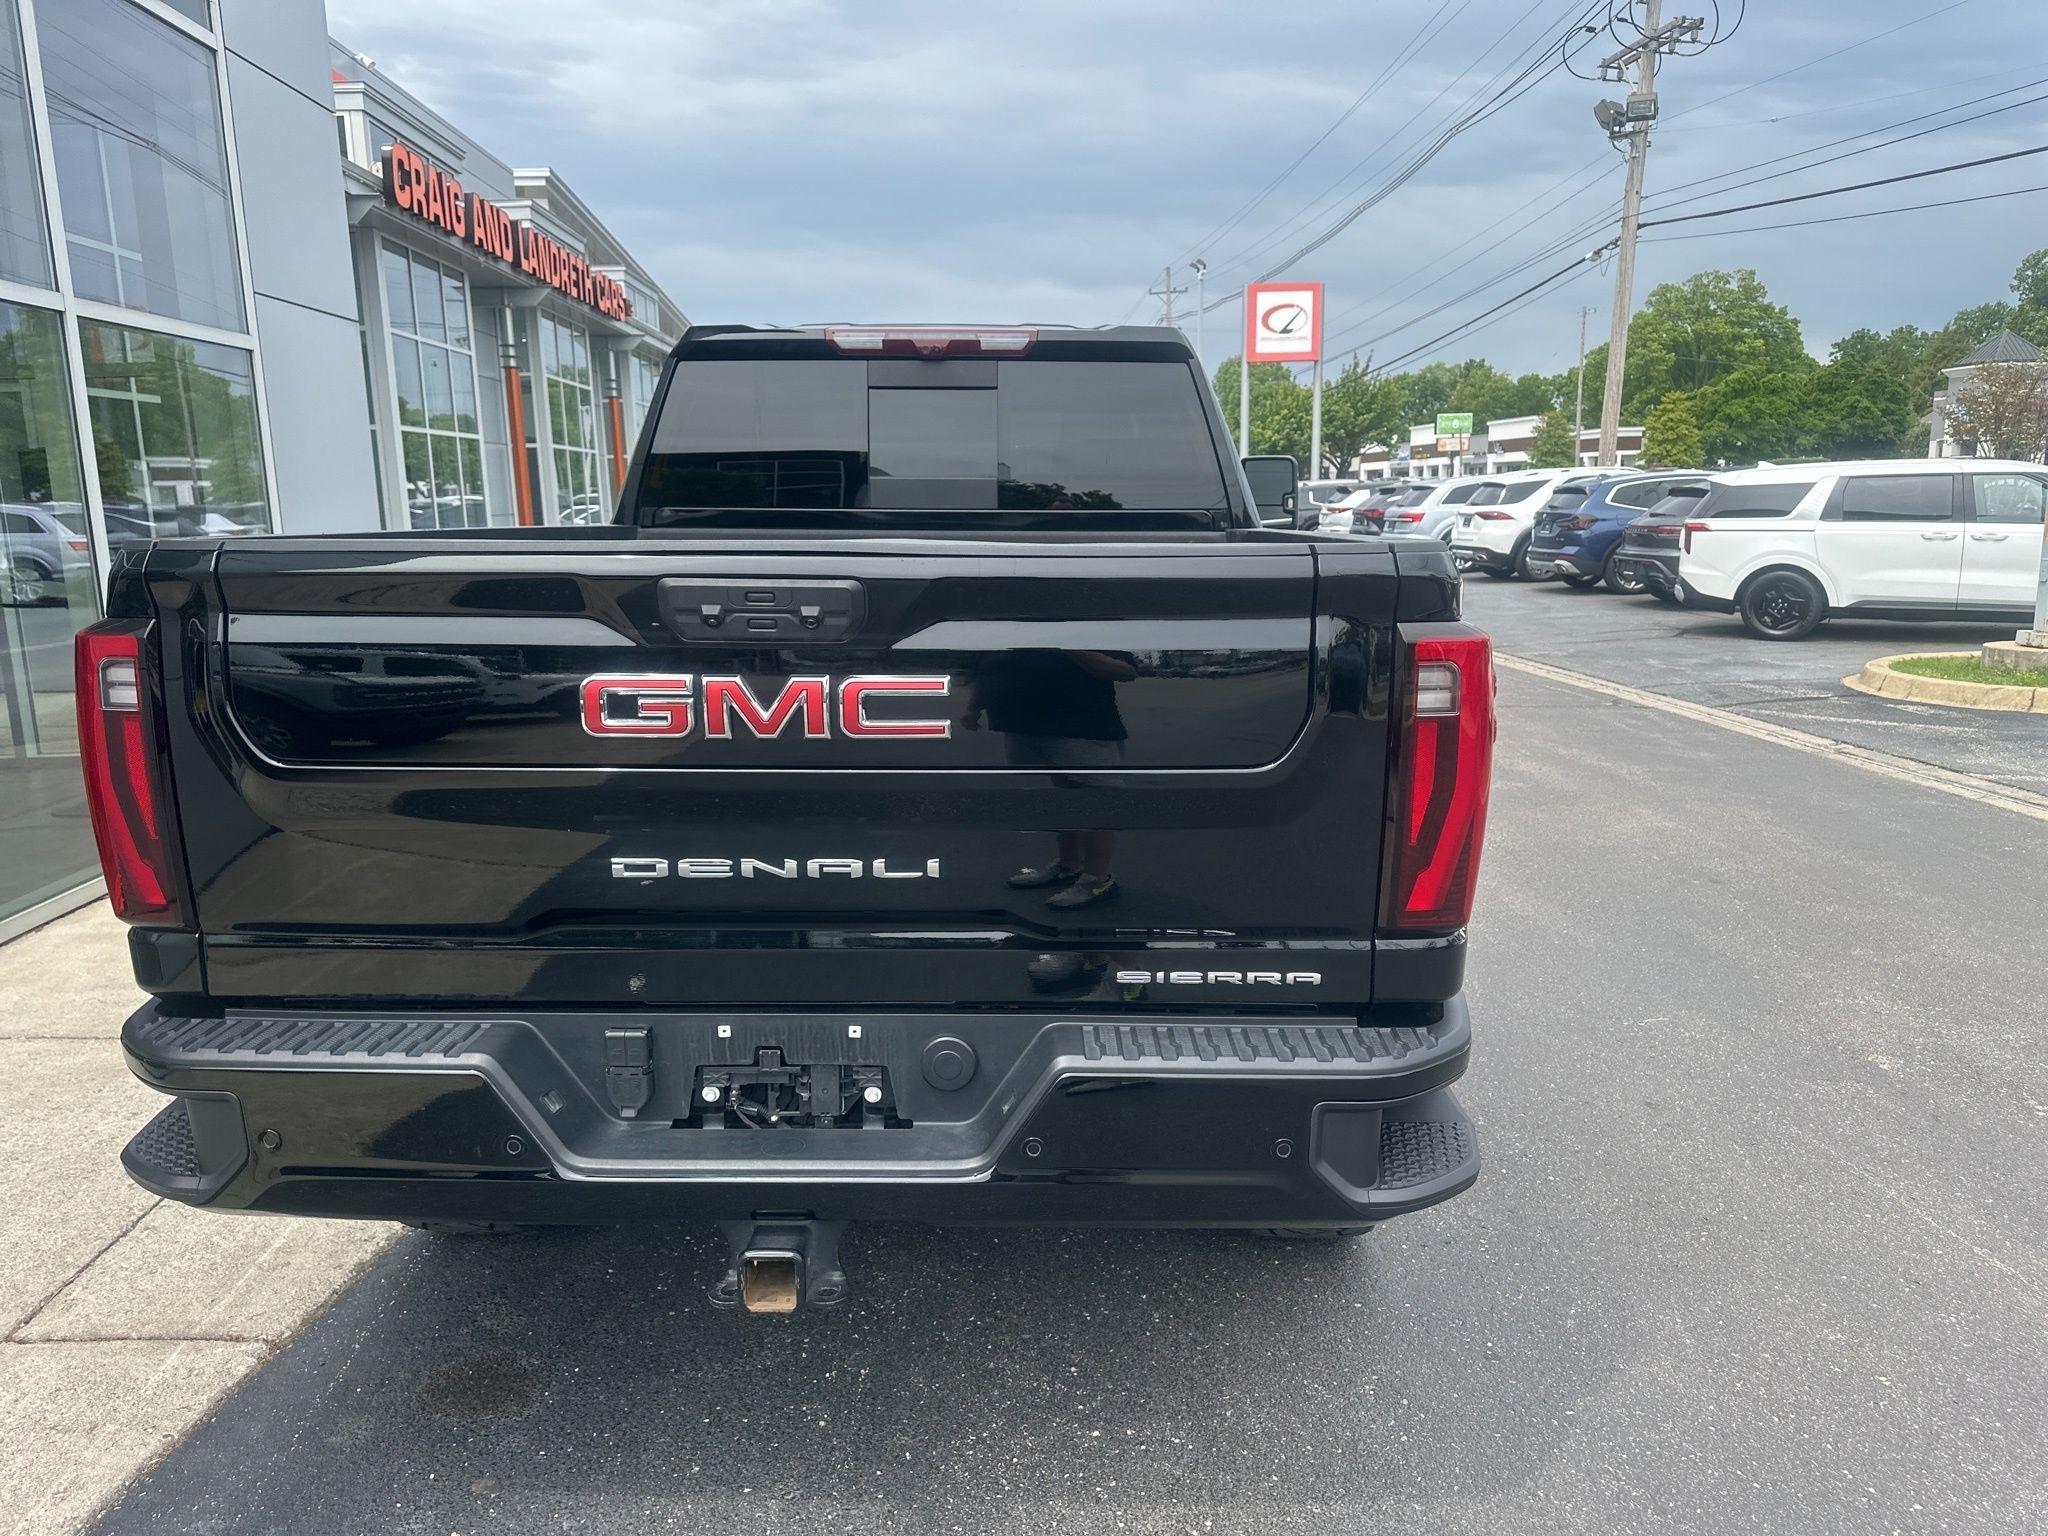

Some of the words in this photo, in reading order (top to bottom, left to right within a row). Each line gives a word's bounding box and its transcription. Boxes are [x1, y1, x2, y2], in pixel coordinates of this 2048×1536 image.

[391, 142, 466, 239] CRAIG
[472, 191, 514, 263] AND
[517, 219, 594, 306] LANDRETH
[596, 271, 626, 322] CARS
[579, 673, 952, 739] GMC
[610, 857, 940, 879] DENALI
[1116, 970, 1322, 985] SIERRA
